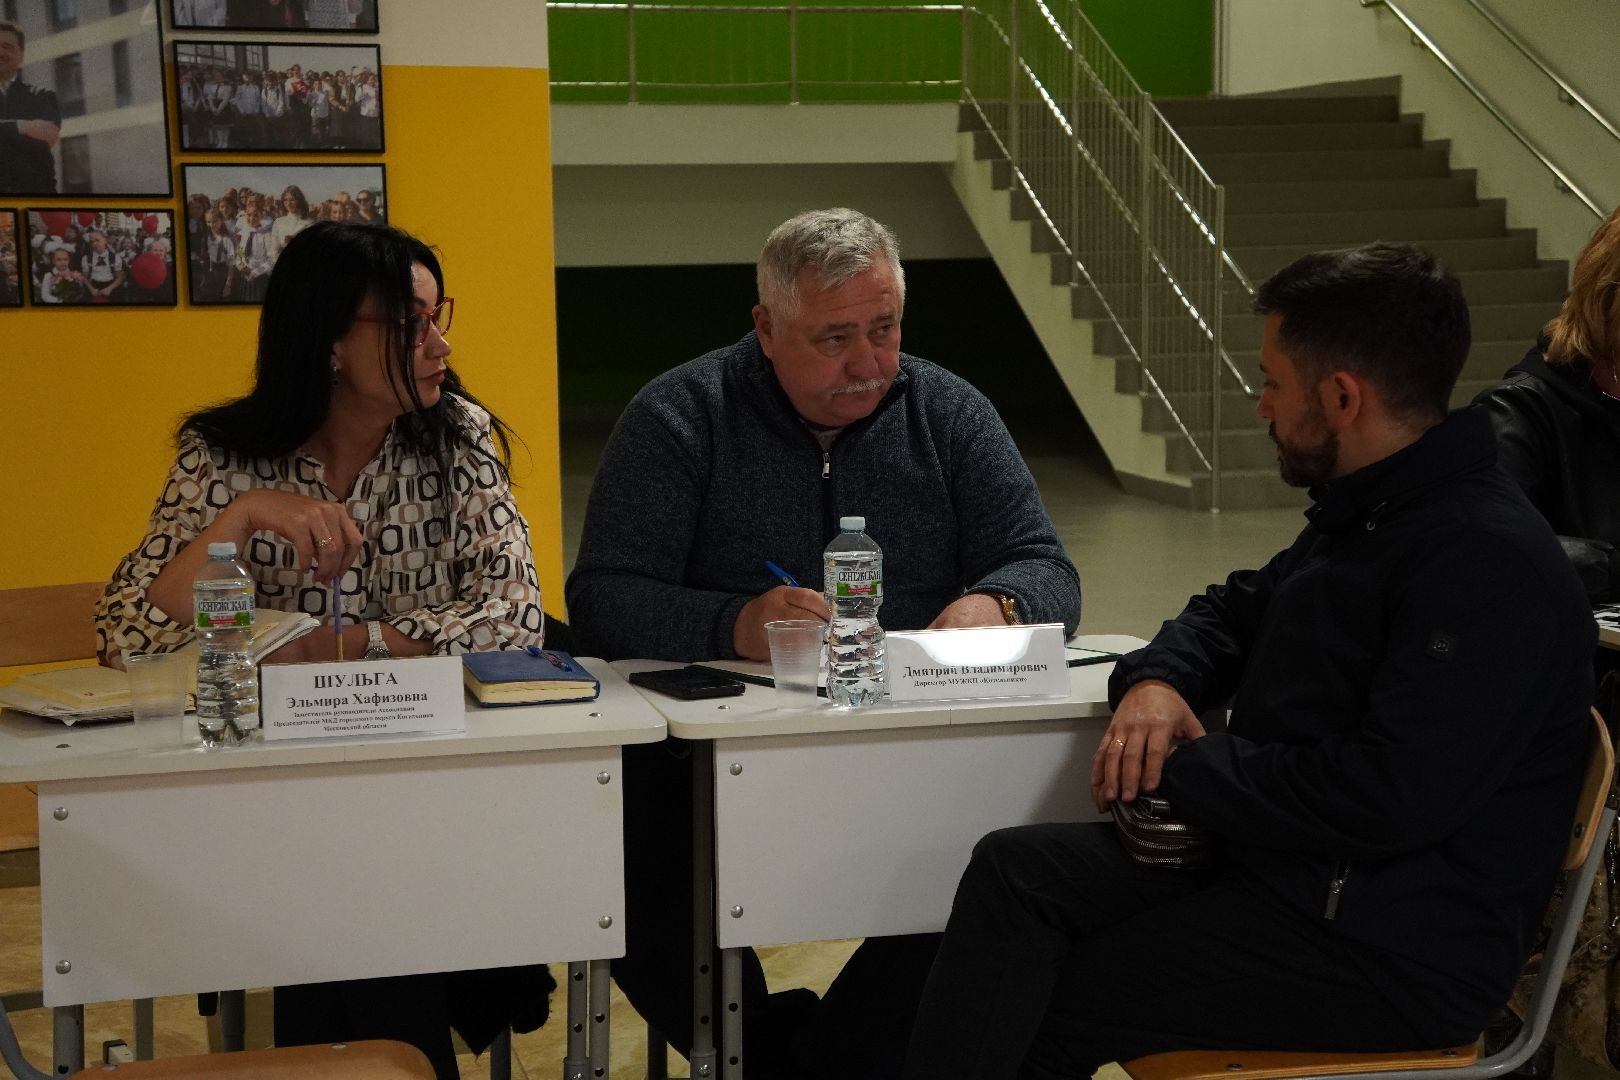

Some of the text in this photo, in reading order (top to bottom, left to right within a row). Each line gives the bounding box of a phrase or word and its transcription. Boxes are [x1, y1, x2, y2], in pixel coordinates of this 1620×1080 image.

[198, 600, 247, 612] СЕНЕЖСКАЯ
[903, 663, 1048, 679] Дмитрий Владимирович
[314, 672, 399, 689] ШУЛЬГА
[286, 691, 428, 709] Эльмира Хафизовна
